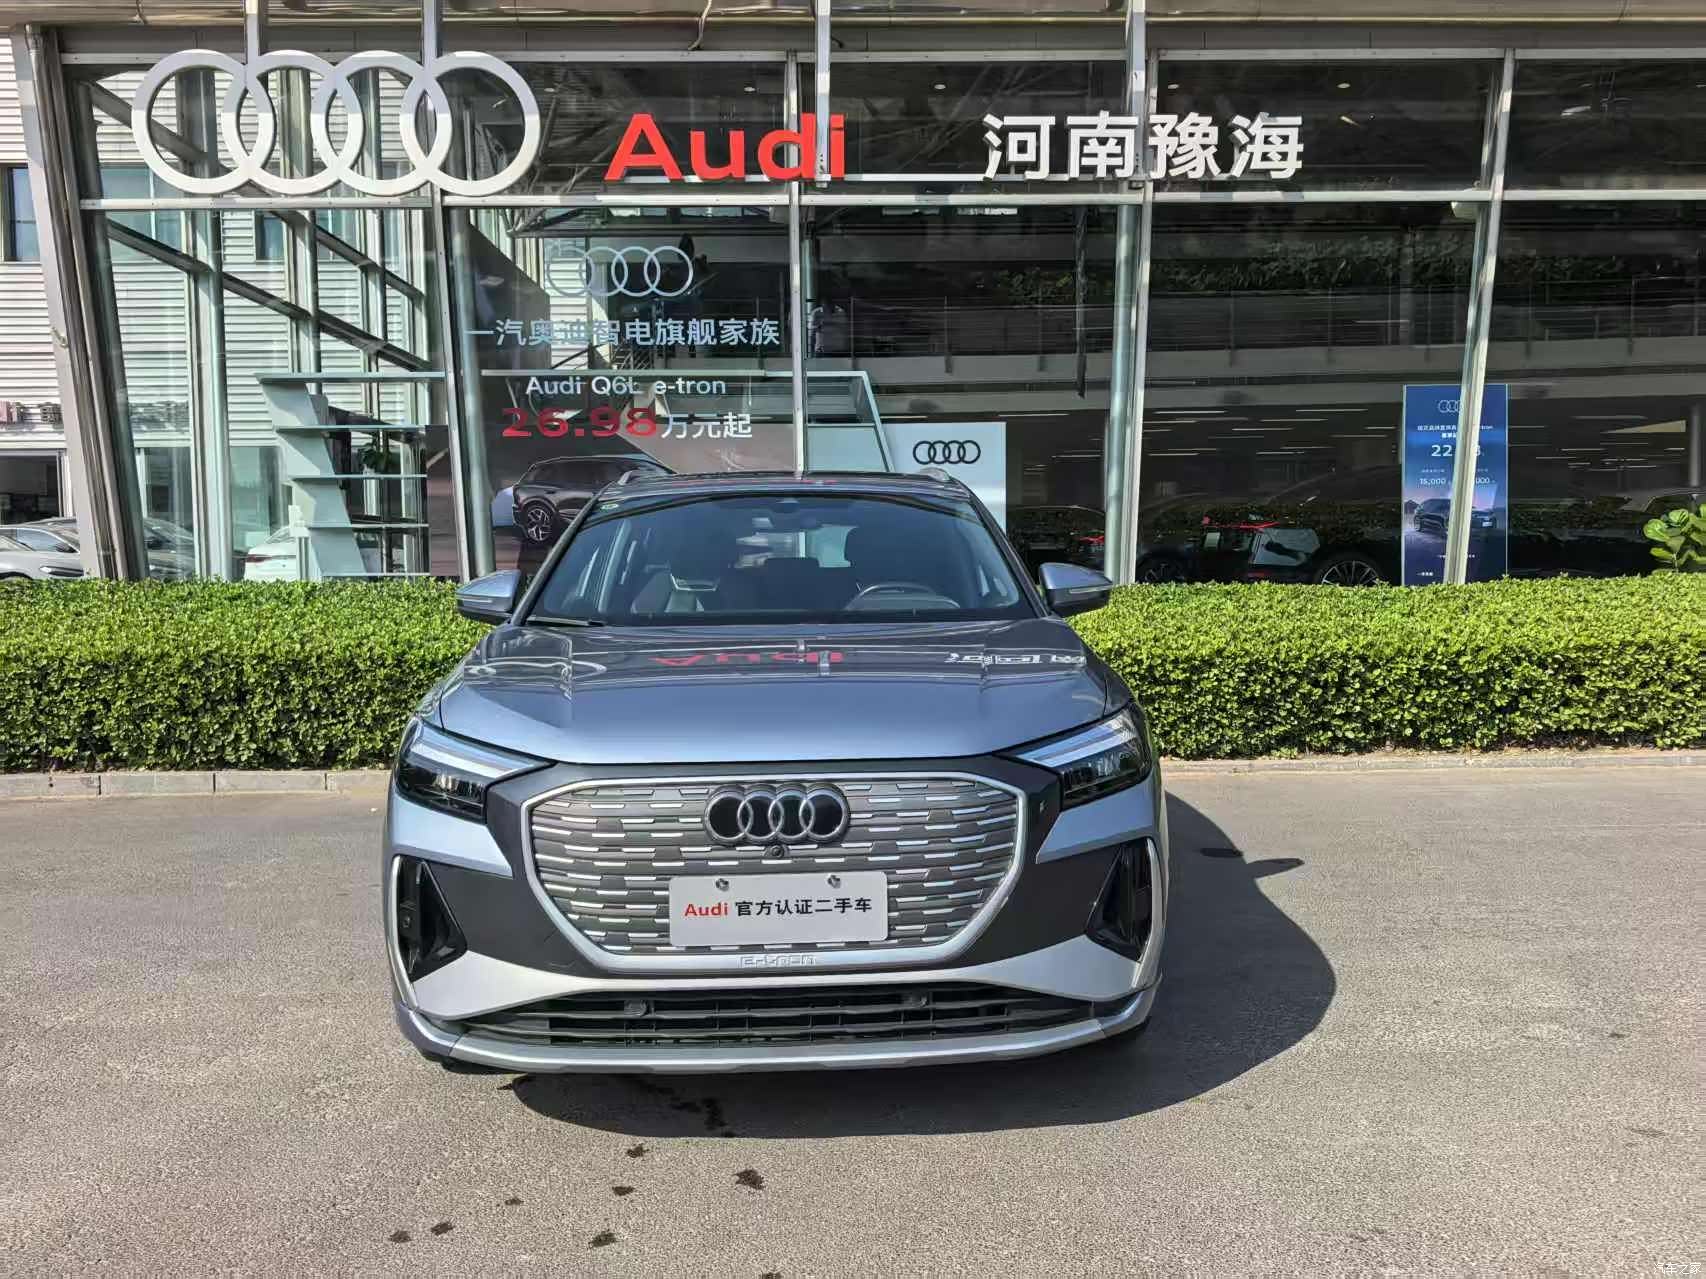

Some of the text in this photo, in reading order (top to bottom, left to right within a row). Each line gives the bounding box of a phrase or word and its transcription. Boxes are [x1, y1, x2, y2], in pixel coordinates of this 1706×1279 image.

[604, 113, 845, 181] Audi
[982, 110, 1304, 180] 河南豫海
[464, 318, 781, 346] 一汽奥迪智电旗舰家族
[525, 376, 582, 395] Audi
[654, 377, 726, 395] e-tron
[684, 897, 872, 917] Audi 官方认证二手车
